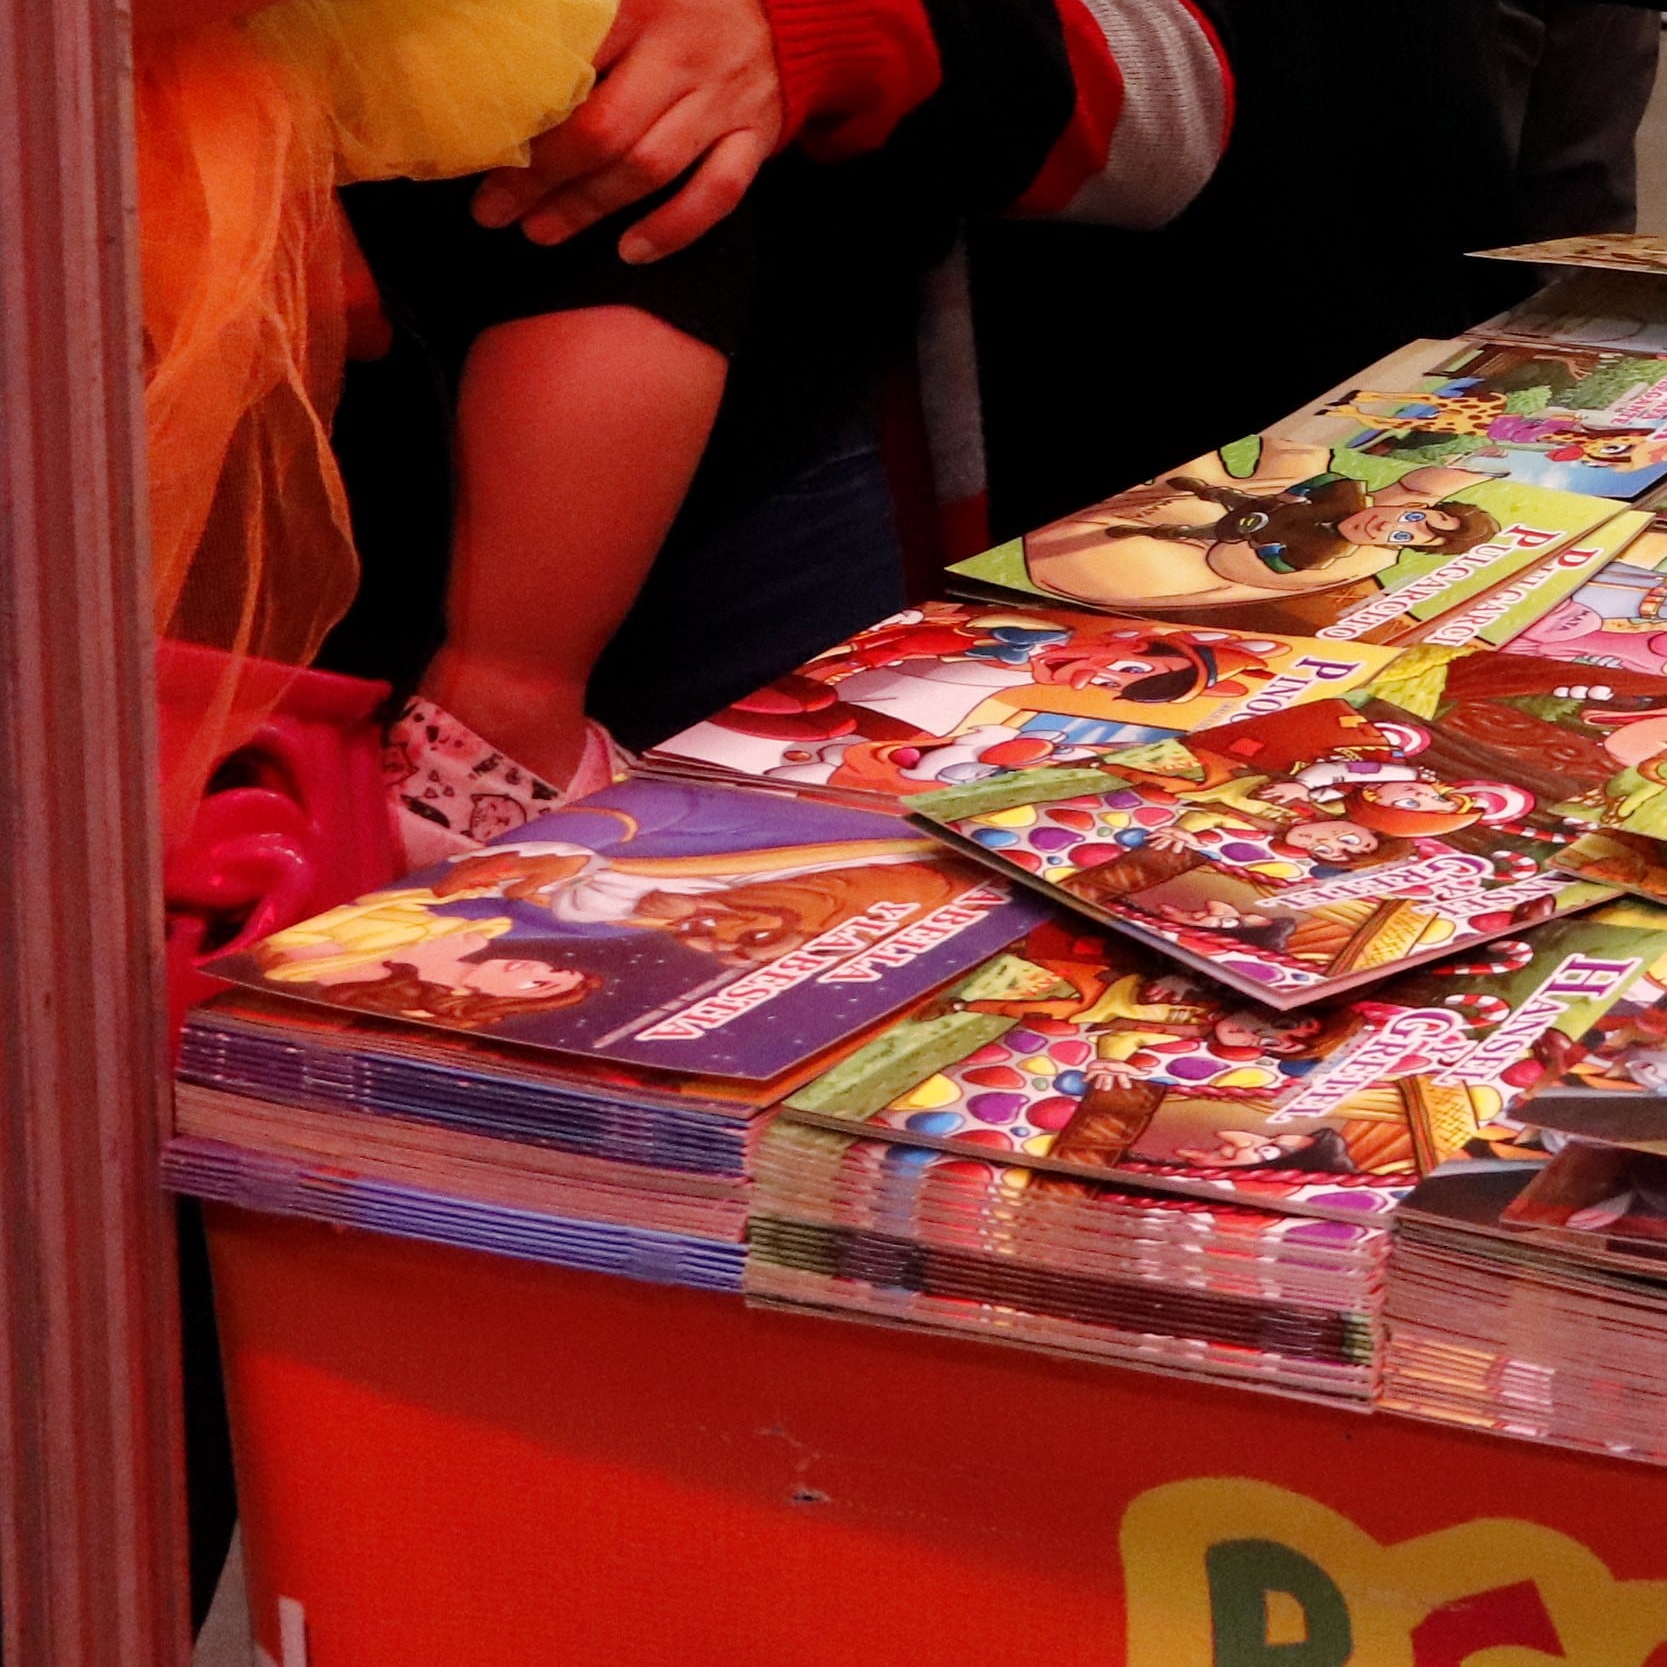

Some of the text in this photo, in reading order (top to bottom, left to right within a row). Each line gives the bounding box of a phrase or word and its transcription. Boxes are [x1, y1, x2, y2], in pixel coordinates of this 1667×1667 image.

[1318, 525, 1561, 642] PULGARCITO
[636, 954, 822, 1040] BESTIA
[1450, 956, 1641, 1086] HANSEL
[1268, 1010, 1464, 1122] GRETEL
